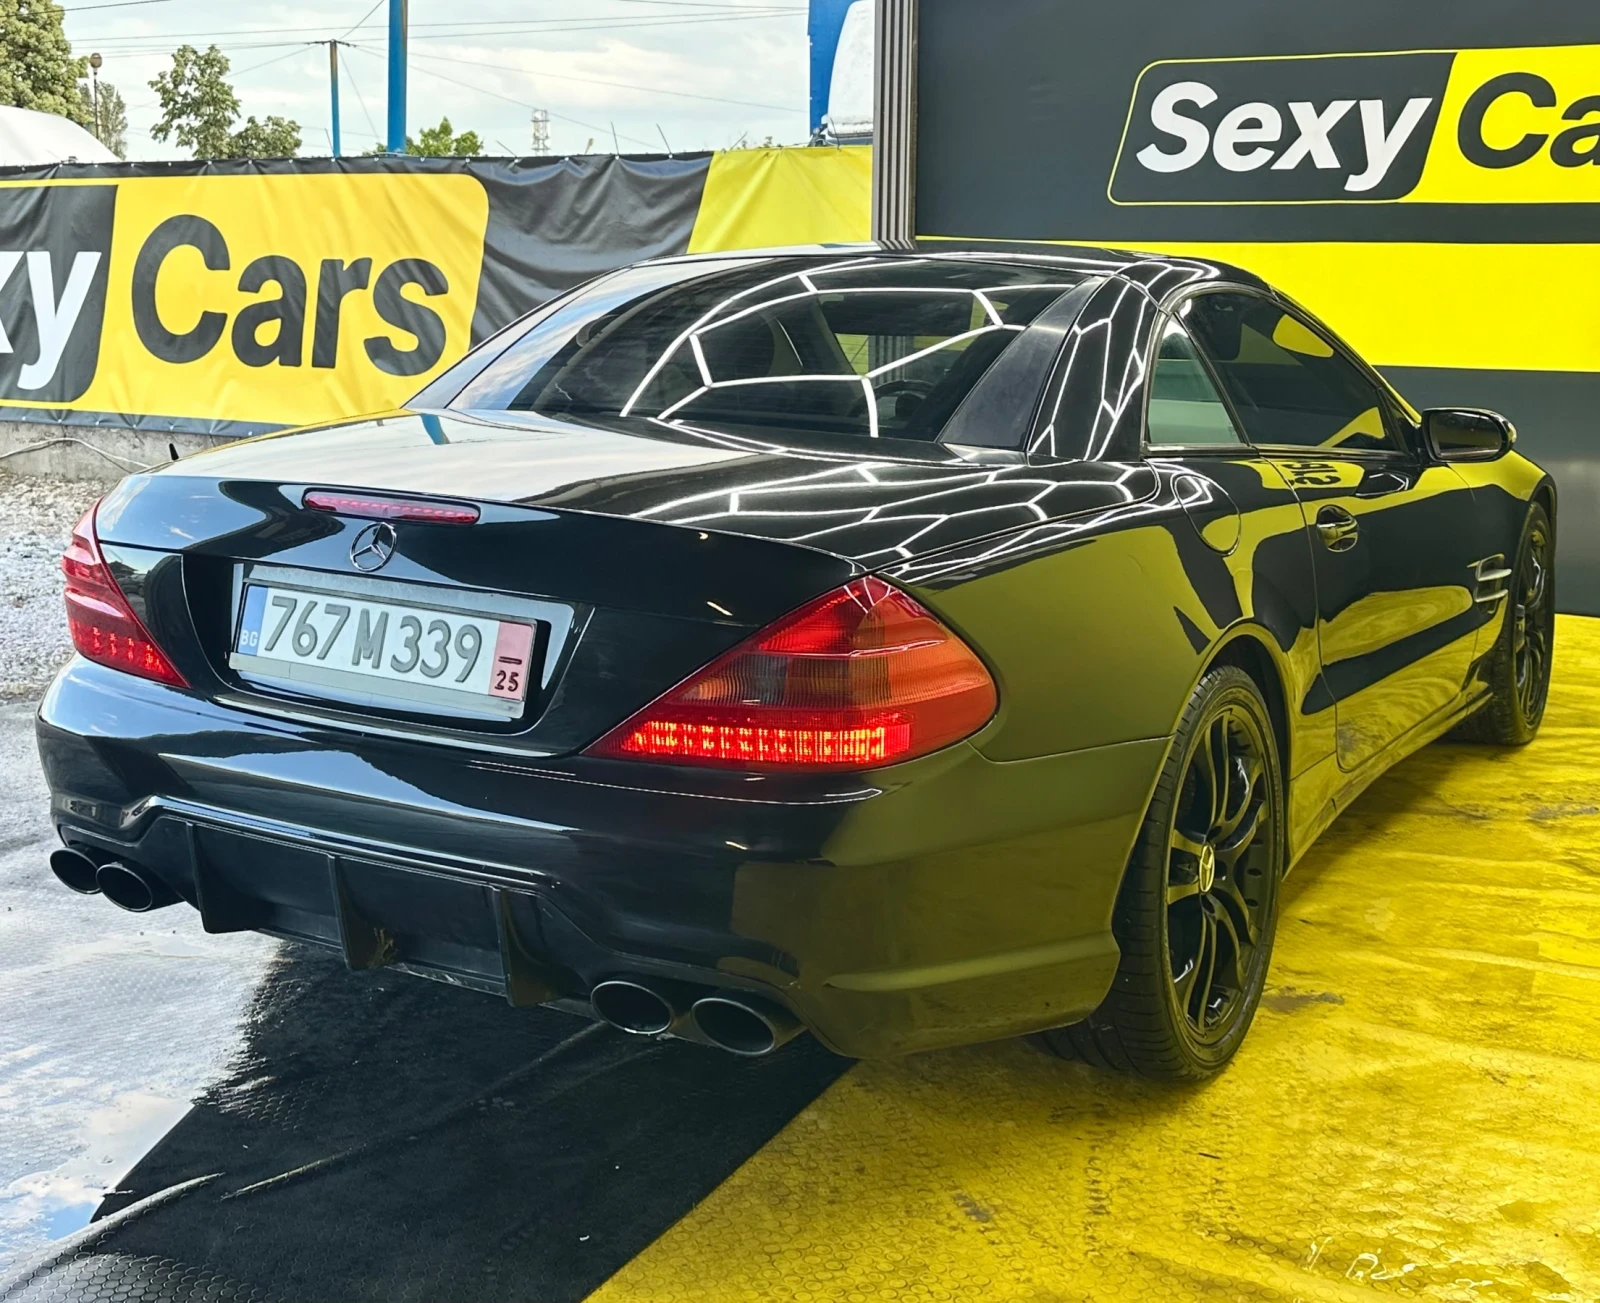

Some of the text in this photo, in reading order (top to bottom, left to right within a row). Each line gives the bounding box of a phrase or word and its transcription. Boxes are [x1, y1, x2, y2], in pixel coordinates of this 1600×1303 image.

[1136, 72, 1600, 192] Sexy Ca
[131, 214, 449, 376] Cars
[239, 628, 258, 647] BG
[494, 670, 519, 692] 25
